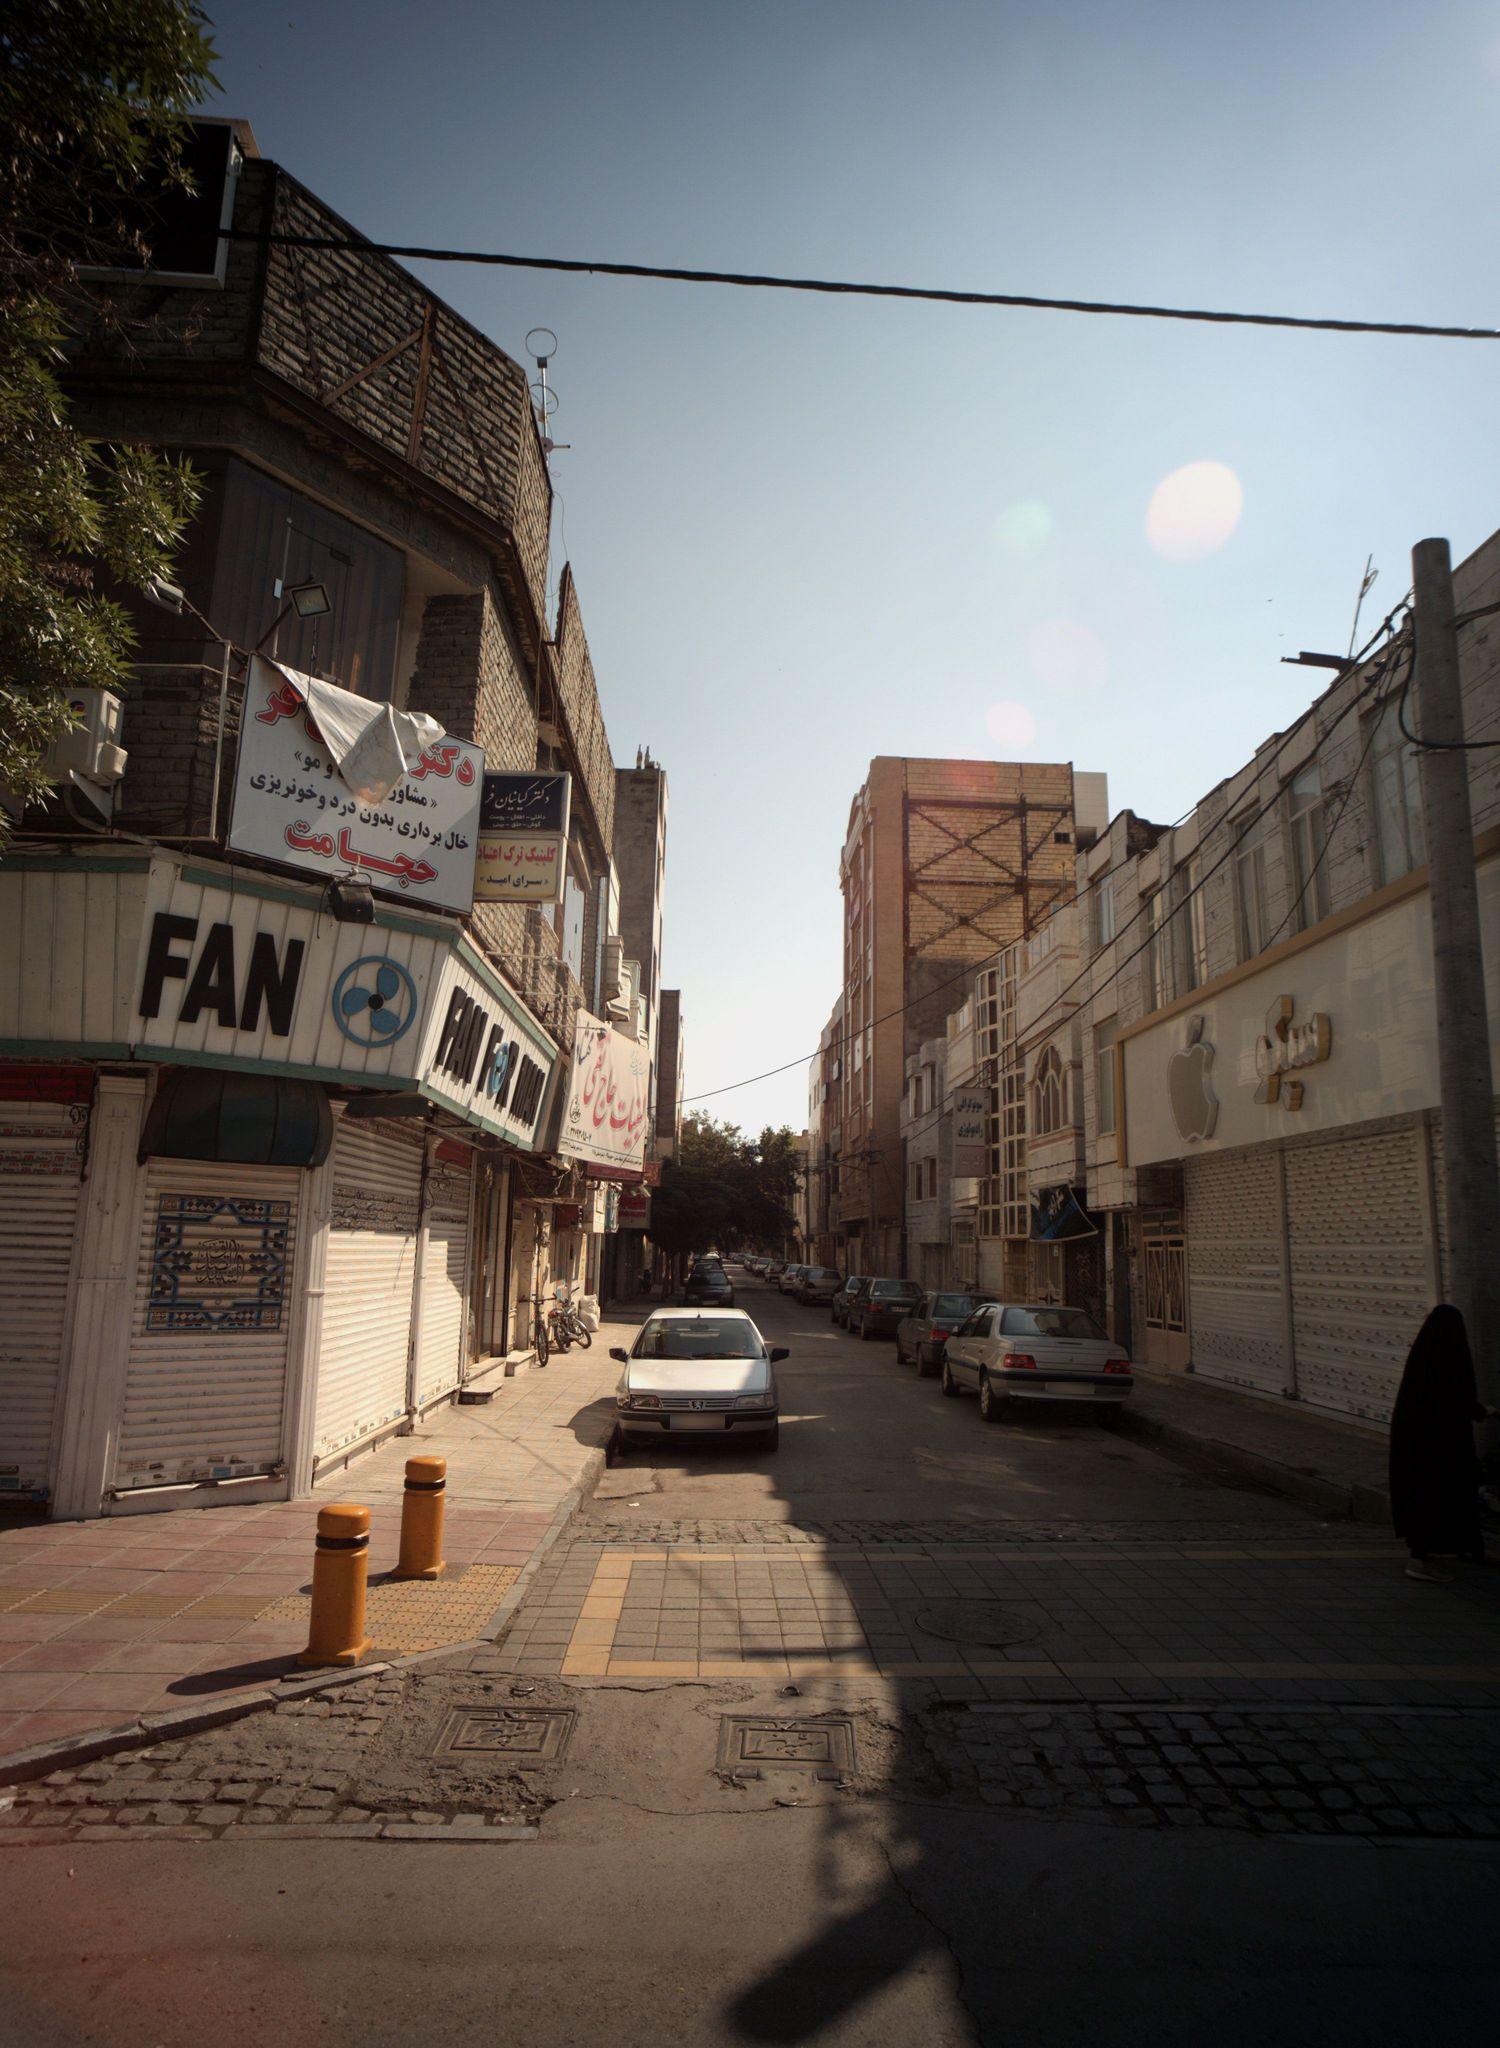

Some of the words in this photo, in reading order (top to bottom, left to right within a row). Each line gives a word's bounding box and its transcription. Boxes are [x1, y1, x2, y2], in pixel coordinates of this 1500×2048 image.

[408, 745, 477, 787] دکتر
[331, 793, 357, 816] درد
[526, 777, 560, 808] دکتر
[359, 806, 395, 833] بدون
[283, 819, 440, 889] حجامت
[444, 833, 470, 850] خال
[138, 911, 306, 1037] FAN
[434, 984, 489, 1085] FAN
